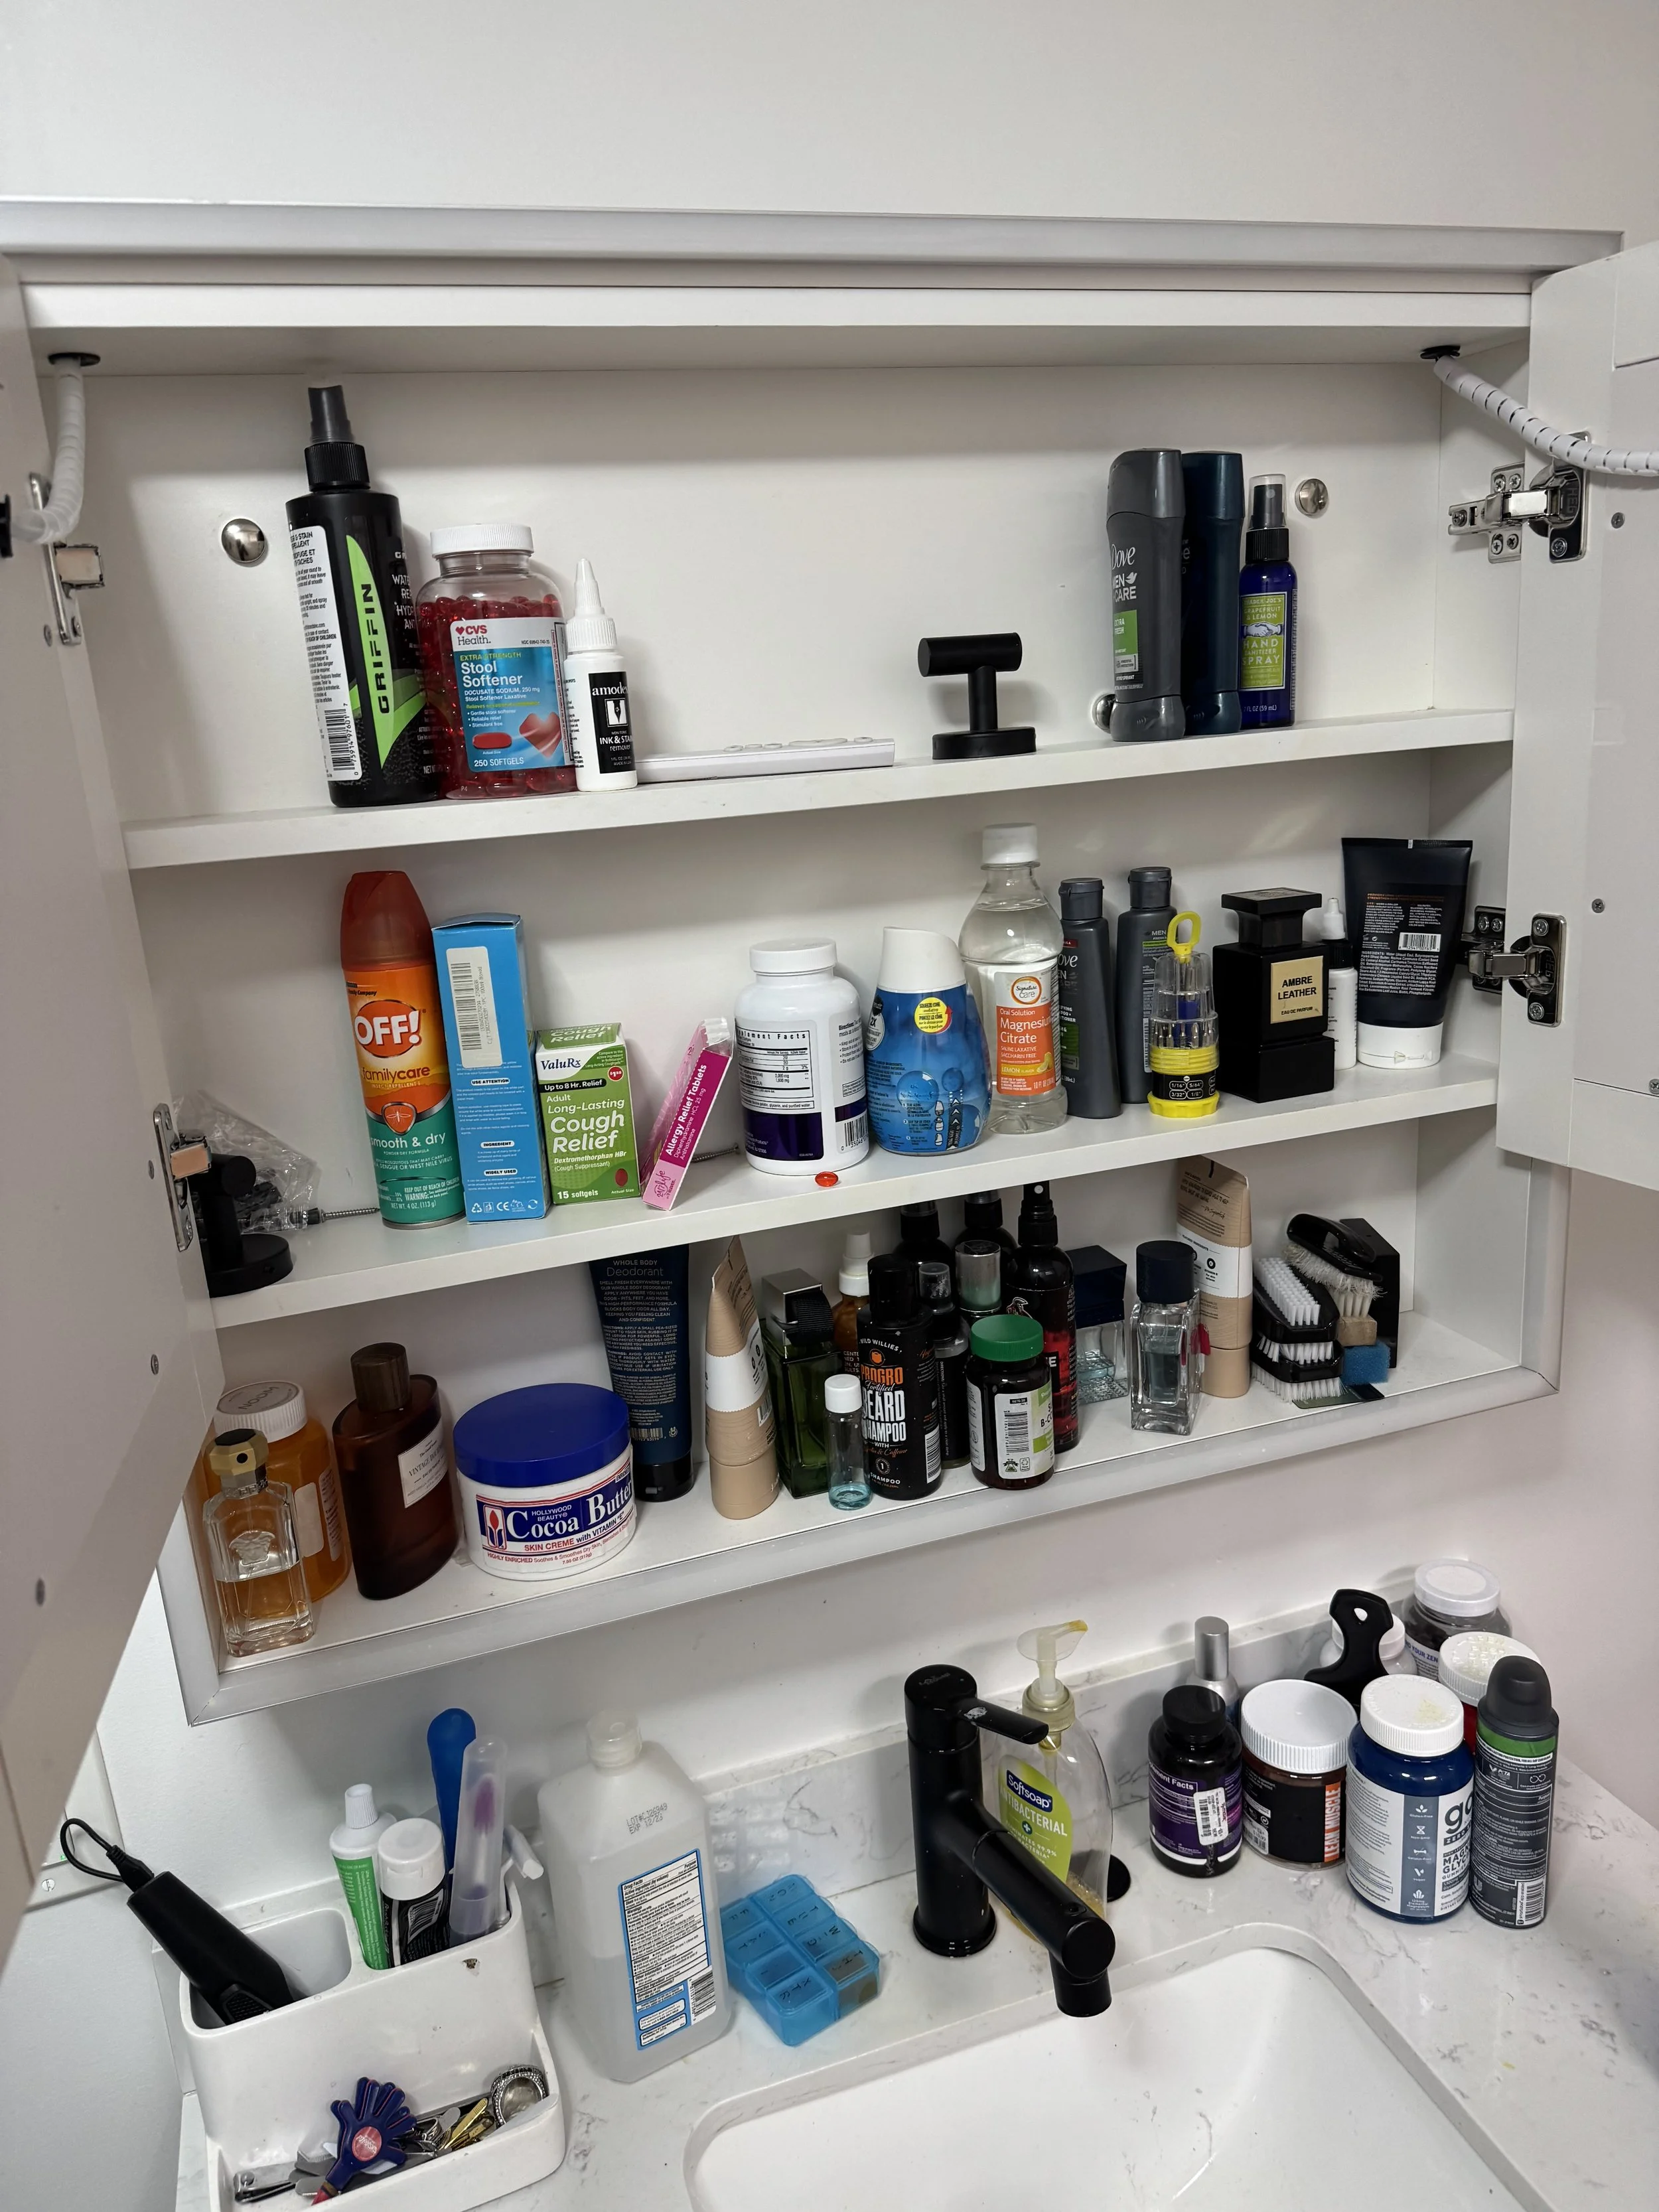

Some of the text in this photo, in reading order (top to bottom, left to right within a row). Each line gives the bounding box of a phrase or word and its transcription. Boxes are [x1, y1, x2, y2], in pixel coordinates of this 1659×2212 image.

[1111, 544, 1136, 570] Dove
[465, 625, 488, 635] CVS
[457, 635, 492, 646] Health.
[1243, 638, 1279, 650] HAND
[361, 583, 390, 714] GRIFFIN
[461, 660, 497, 674] Stool
[1242, 655, 1280, 666] SPRAY
[463, 674, 523, 688] Softener
[599, 735, 620, 745] INK &
[610, 743, 630, 751] remover
[489, 757, 524, 766] SOFTGELS
[1281, 975, 1313, 988] AMBRE
[1277, 986, 1317, 1000] LEATHER
[354, 1009, 421, 1046] OFF!
[869, 1016, 877, 1027] 2X
[550, 1031, 606, 1043] Relief
[1000, 1031, 1037, 1044] Citrate
[541, 1057, 581, 1070] ValuRx
[362, 1065, 431, 1083] familycare
[546, 1094, 571, 1103] Adult
[547, 1098, 625, 1115] Long-Lasting
[665, 1064, 707, 1156] Allergy Relief Tablets
[550, 1110, 624, 1134] Cough
[674, 1116, 694, 1158] Diphenhydramine
[699, 1088, 707, 1097] mg
[370, 1132, 446, 1149] smooth & dry
[552, 1130, 618, 1153] Relief
[680, 1128, 696, 1161] Antihistamine
[439, 1155, 453, 1164] VIRUS
[554, 1152, 613, 1164] Dextromethorphan
[574, 1161, 611, 1171] Suppressant)
[405, 1192, 429, 1201] WARNING:
[571, 1189, 599, 1199] softgels
[607, 1267, 664, 1276] Deodorant
[872, 1339, 899, 1352] WILLIES
[861, 1364, 904, 1386] PROGRO
[865, 1380, 896, 1396] Fortified
[862, 1389, 906, 1422] BEARD
[862, 1418, 906, 1443] SHAMPOO
[884, 1449, 908, 1458] Caffeine
[871, 1472, 901, 1485] SHAMPOO
[506, 1479, 632, 1539] Cocoa Butter
[532, 1504, 572, 1516] HOLLYWOOD
[537, 1513, 562, 1522] BEAUTY
[524, 1518, 617, 1552] SKIN CREME with VITAMIN
[487, 1552, 504, 1562] HIGHLY
[591, 1542, 603, 1552] Skin,
[1412, 1645, 1438, 1663] YOUR ZEN
[1007, 1775, 1050, 1808] Softsoap
[1172, 1779, 1194, 1791] Facts
[1001, 1785, 1068, 1837] ANTIBACTERIAL
[628, 1823, 641, 1834] EXP
[1325, 1787, 1340, 1858] LEAN MUSCLE
[1446, 1830, 1465, 1844] ZERO
[1037, 1843, 1057, 1858] 99.9%
